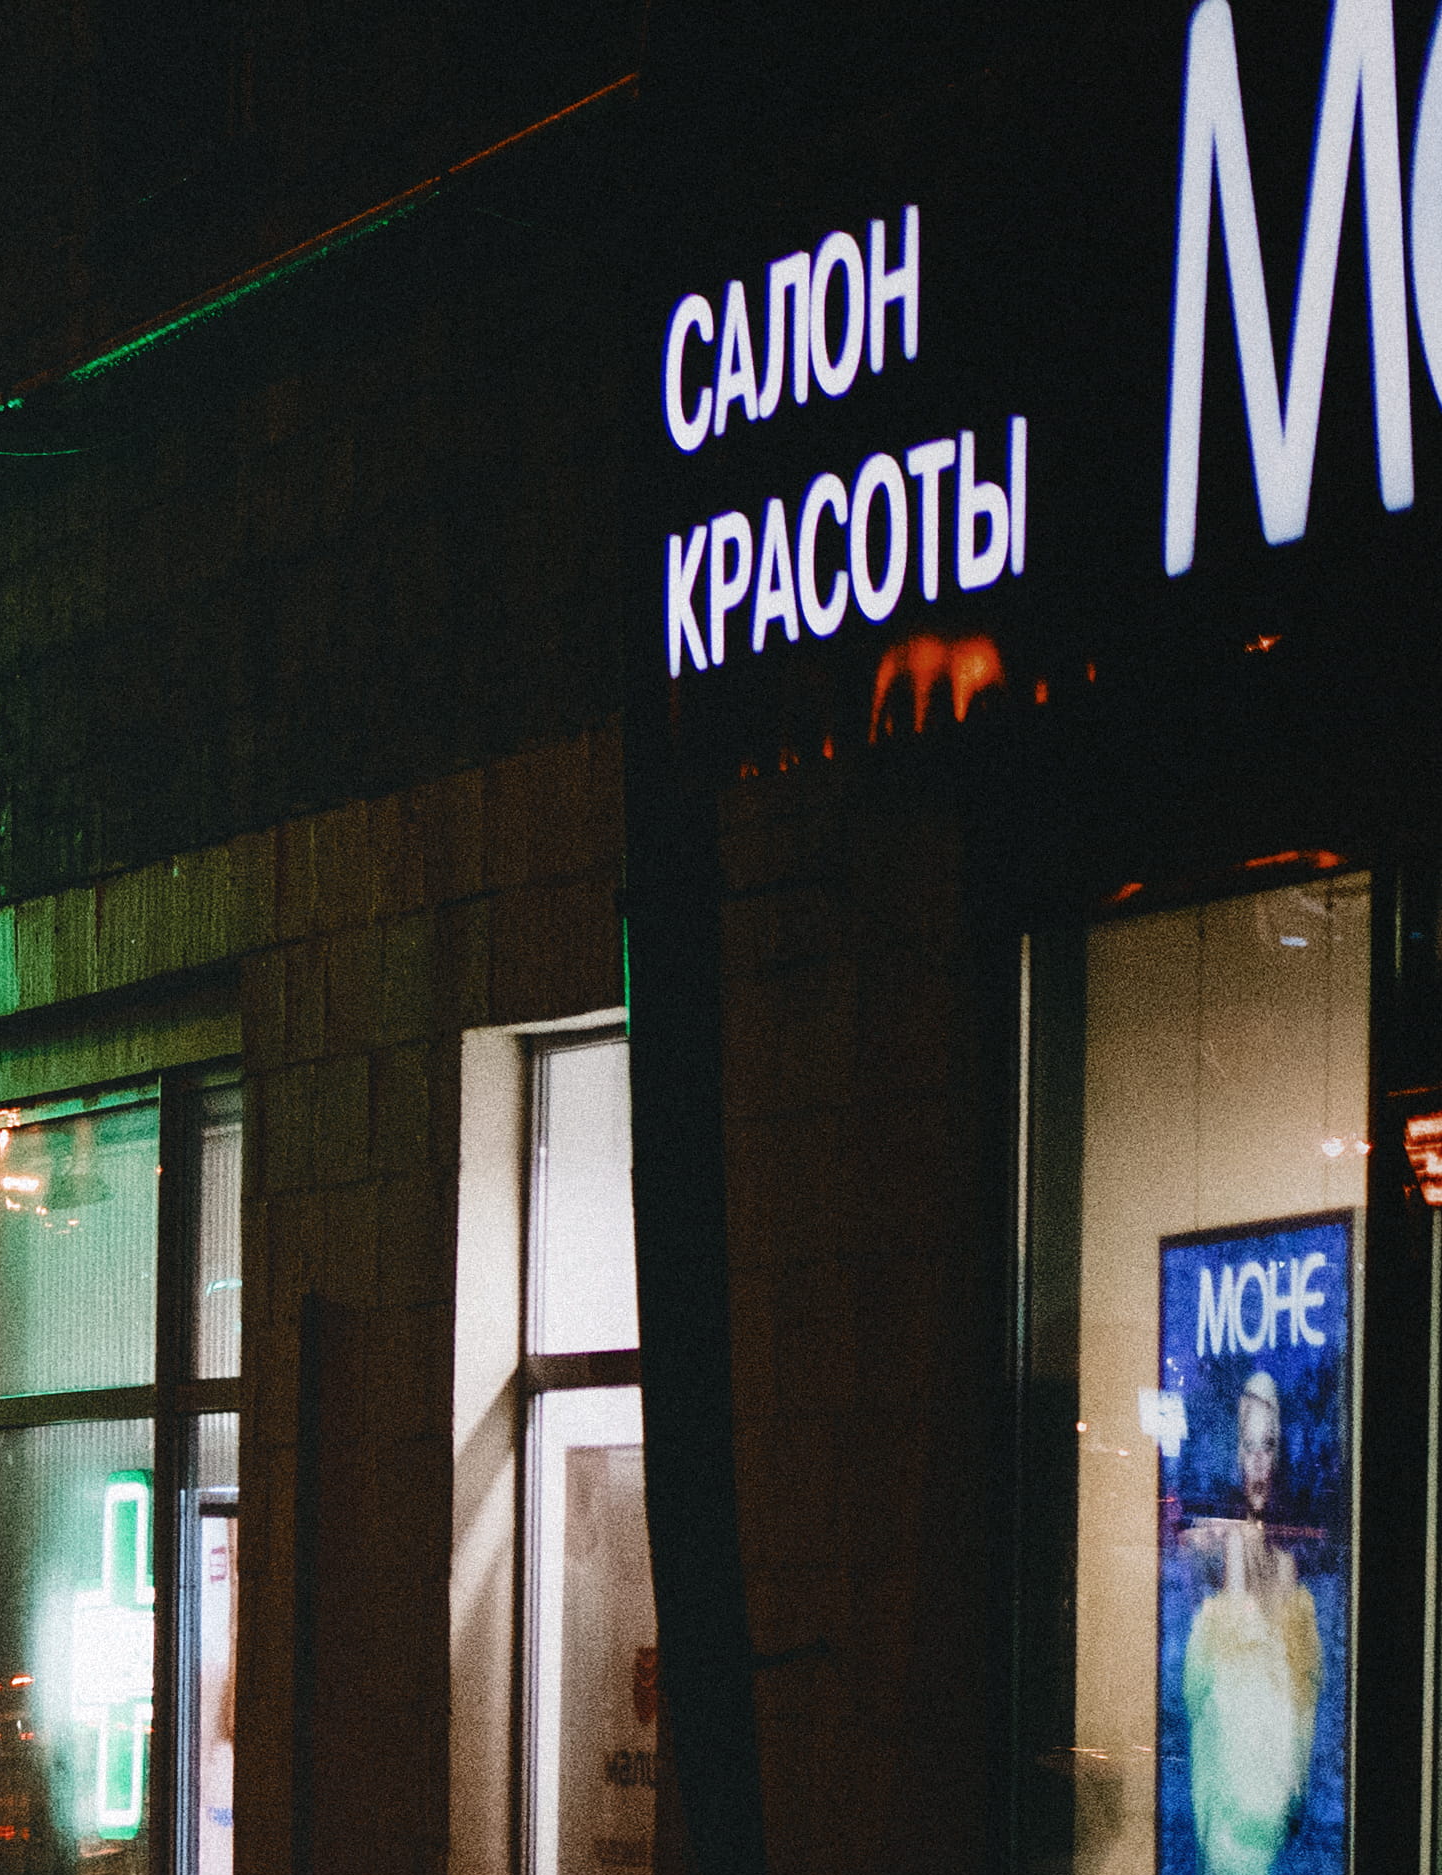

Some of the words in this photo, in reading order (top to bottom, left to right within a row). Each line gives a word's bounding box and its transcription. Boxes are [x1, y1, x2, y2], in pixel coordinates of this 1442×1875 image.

[664, 204, 920, 452] САЛОН
[1164, 0, 1442, 578] М
[666, 414, 1028, 679] КРАСОТЫ
[1196, 1252, 1326, 1358] МОНЕ
